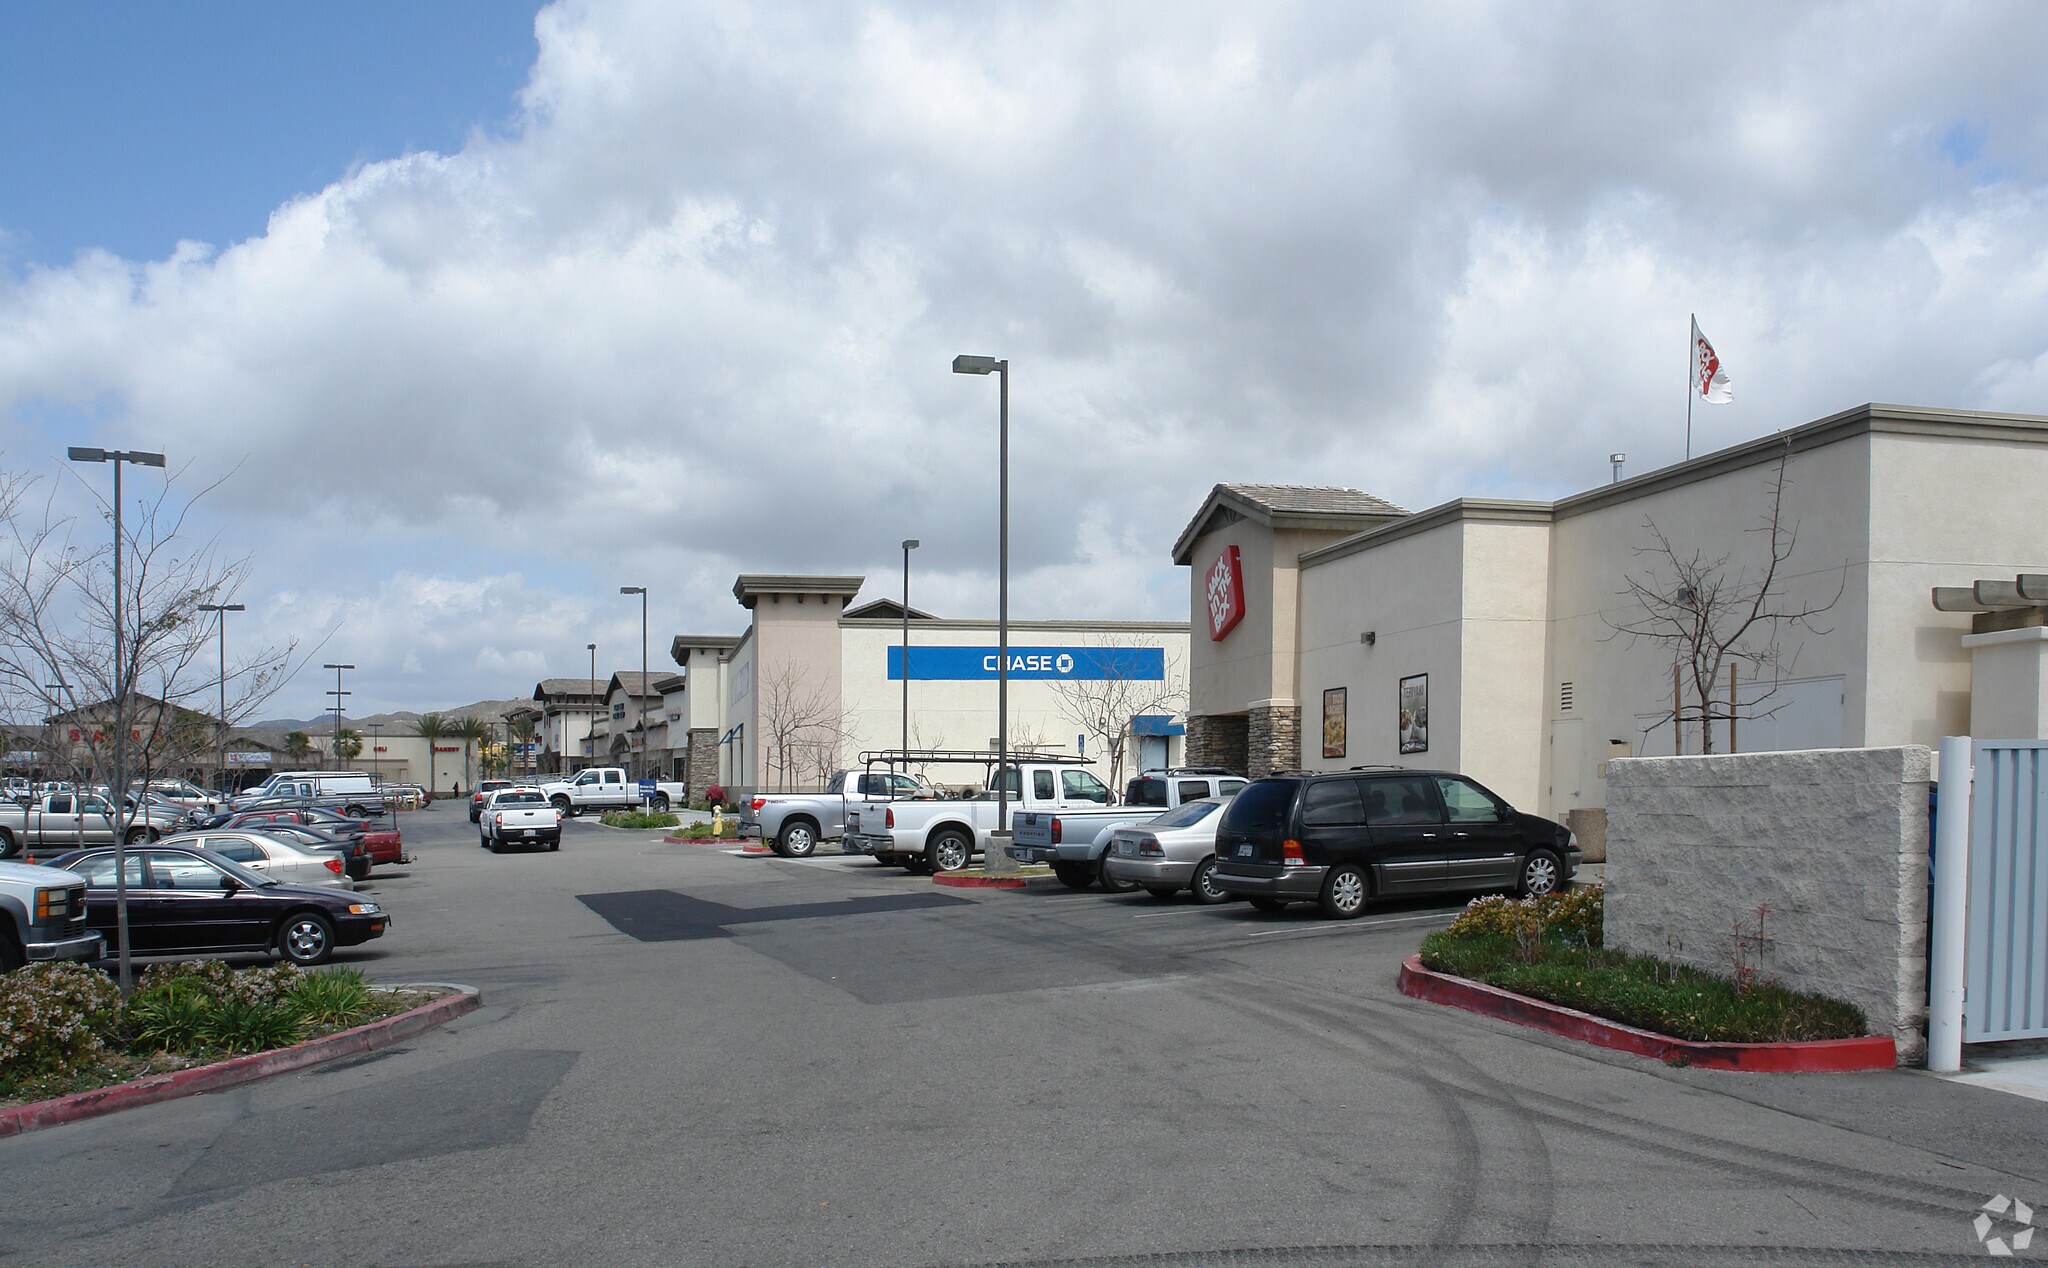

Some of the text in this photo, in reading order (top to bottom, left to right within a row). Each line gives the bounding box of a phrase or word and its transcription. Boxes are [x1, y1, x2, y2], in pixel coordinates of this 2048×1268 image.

[1208, 555, 1226, 601] JACK
[1218, 566, 1232, 598] THE
[1214, 594, 1230, 633] BOX
